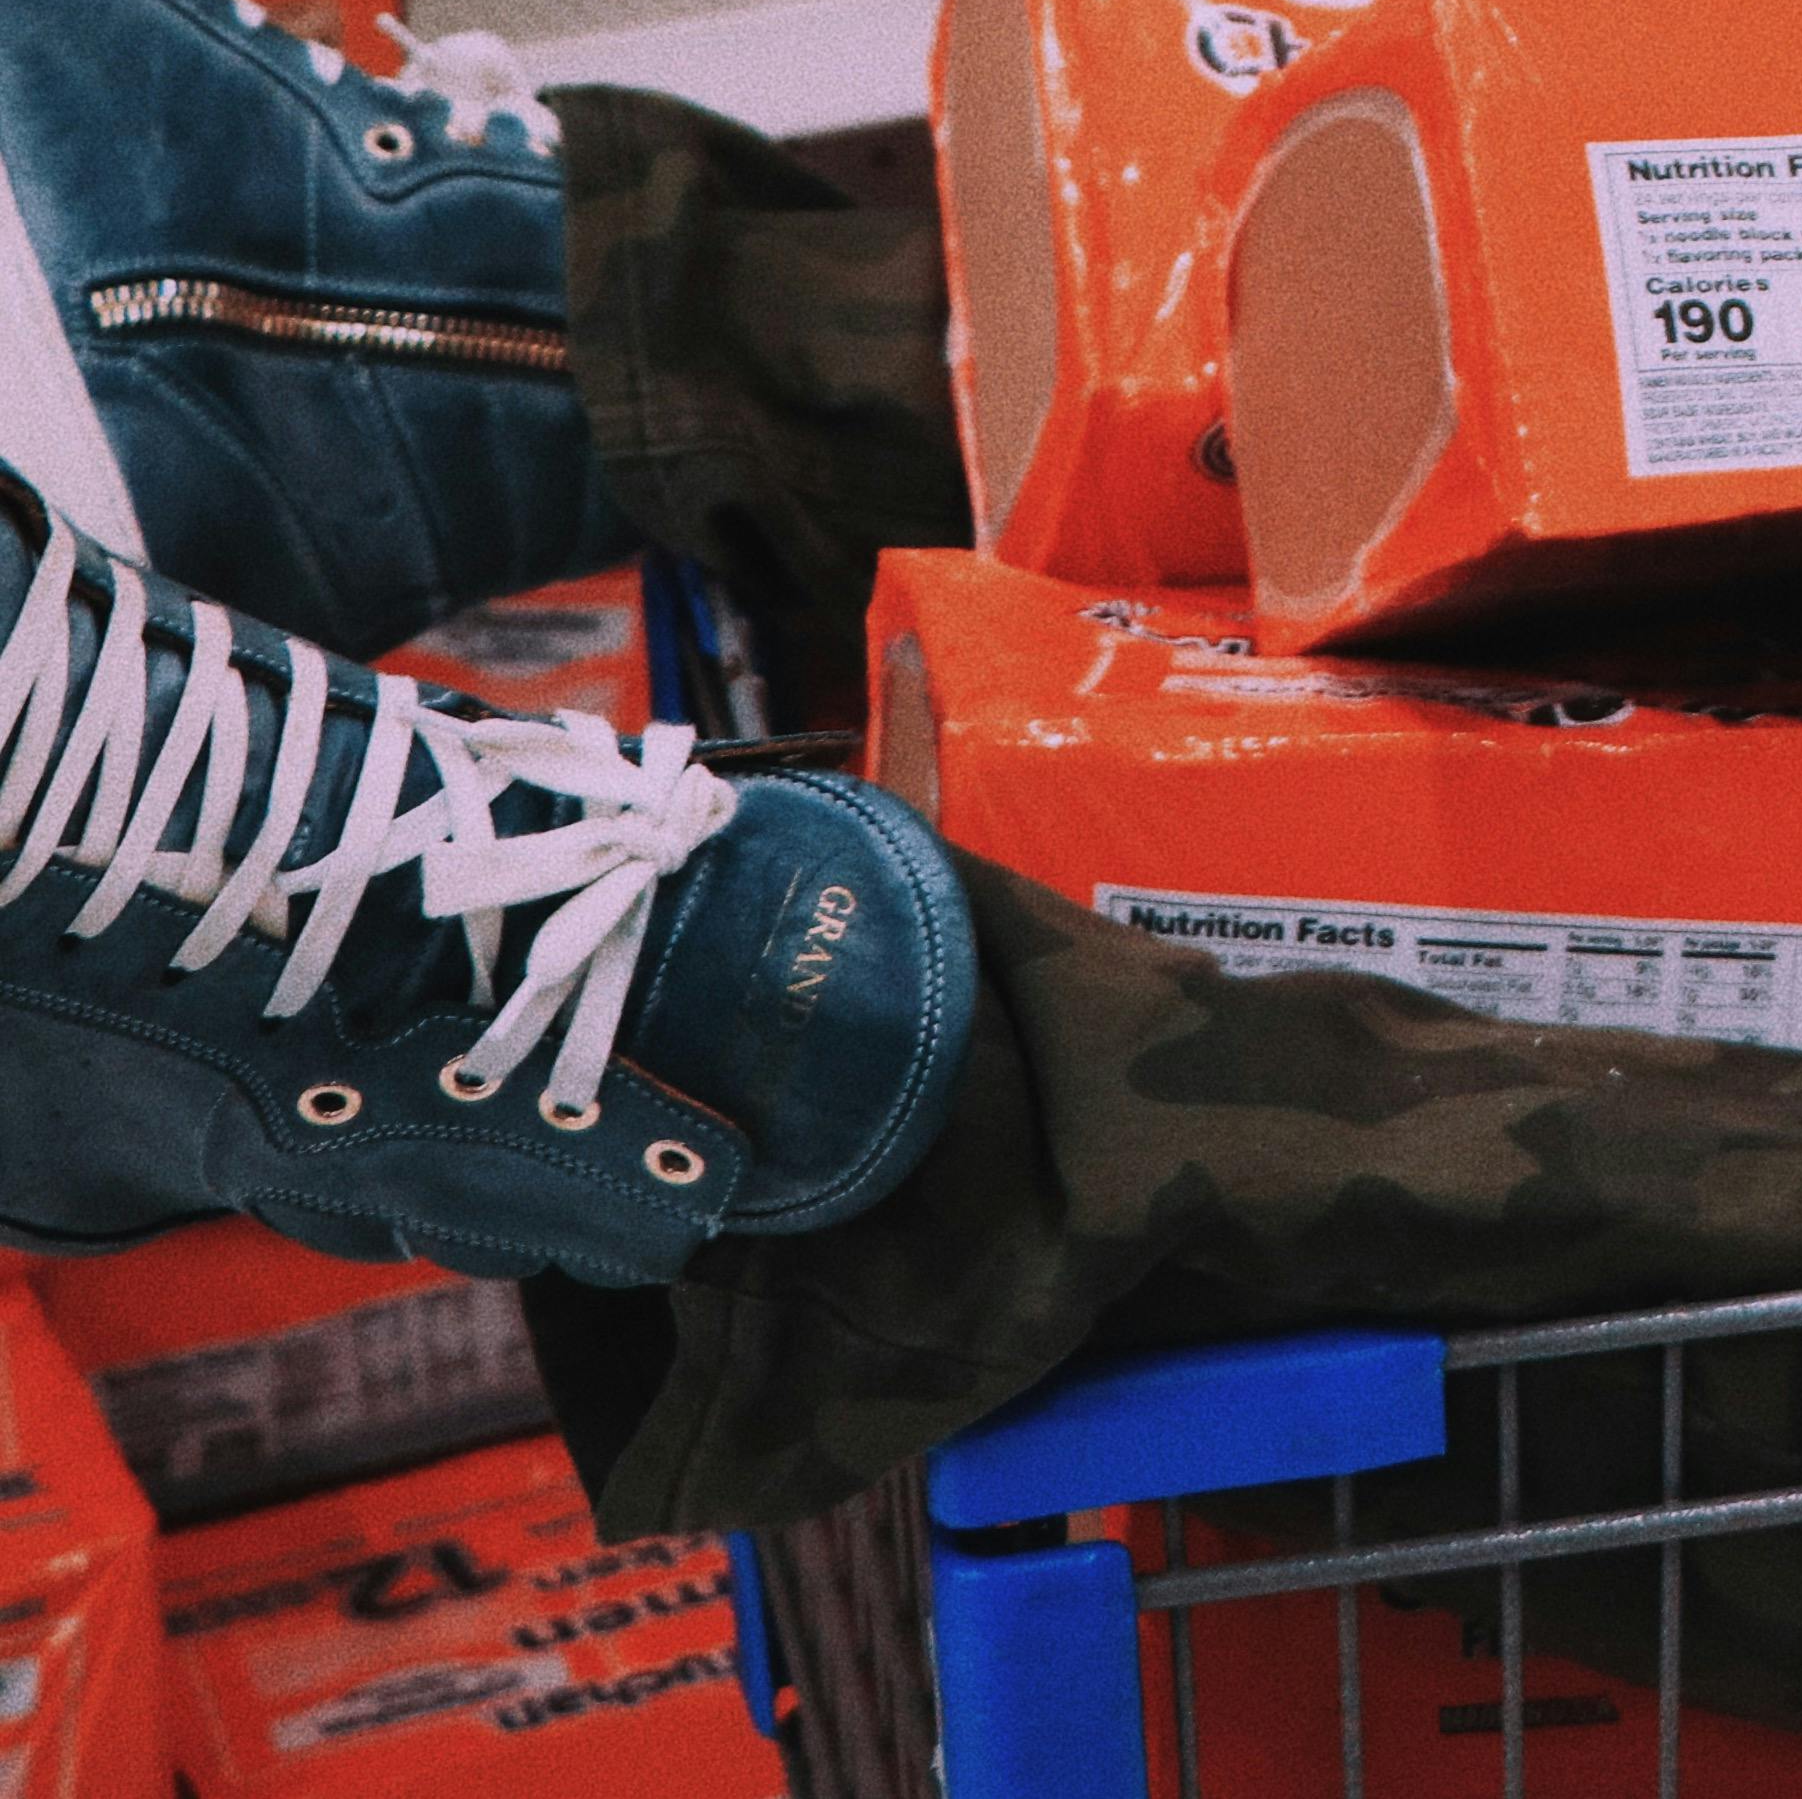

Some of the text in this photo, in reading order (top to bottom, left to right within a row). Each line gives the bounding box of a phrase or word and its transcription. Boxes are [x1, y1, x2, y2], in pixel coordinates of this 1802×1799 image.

[1627, 155, 1776, 181] Nutrition
[1637, 208, 1758, 225] Serving size
[1645, 276, 1770, 295] Calories
[1653, 298, 1755, 344] 190
[1129, 904, 1396, 949] Nutrition Facts
[1417, 950, 1503, 968] Total Fat
[326, 1543, 506, 1624] 12
